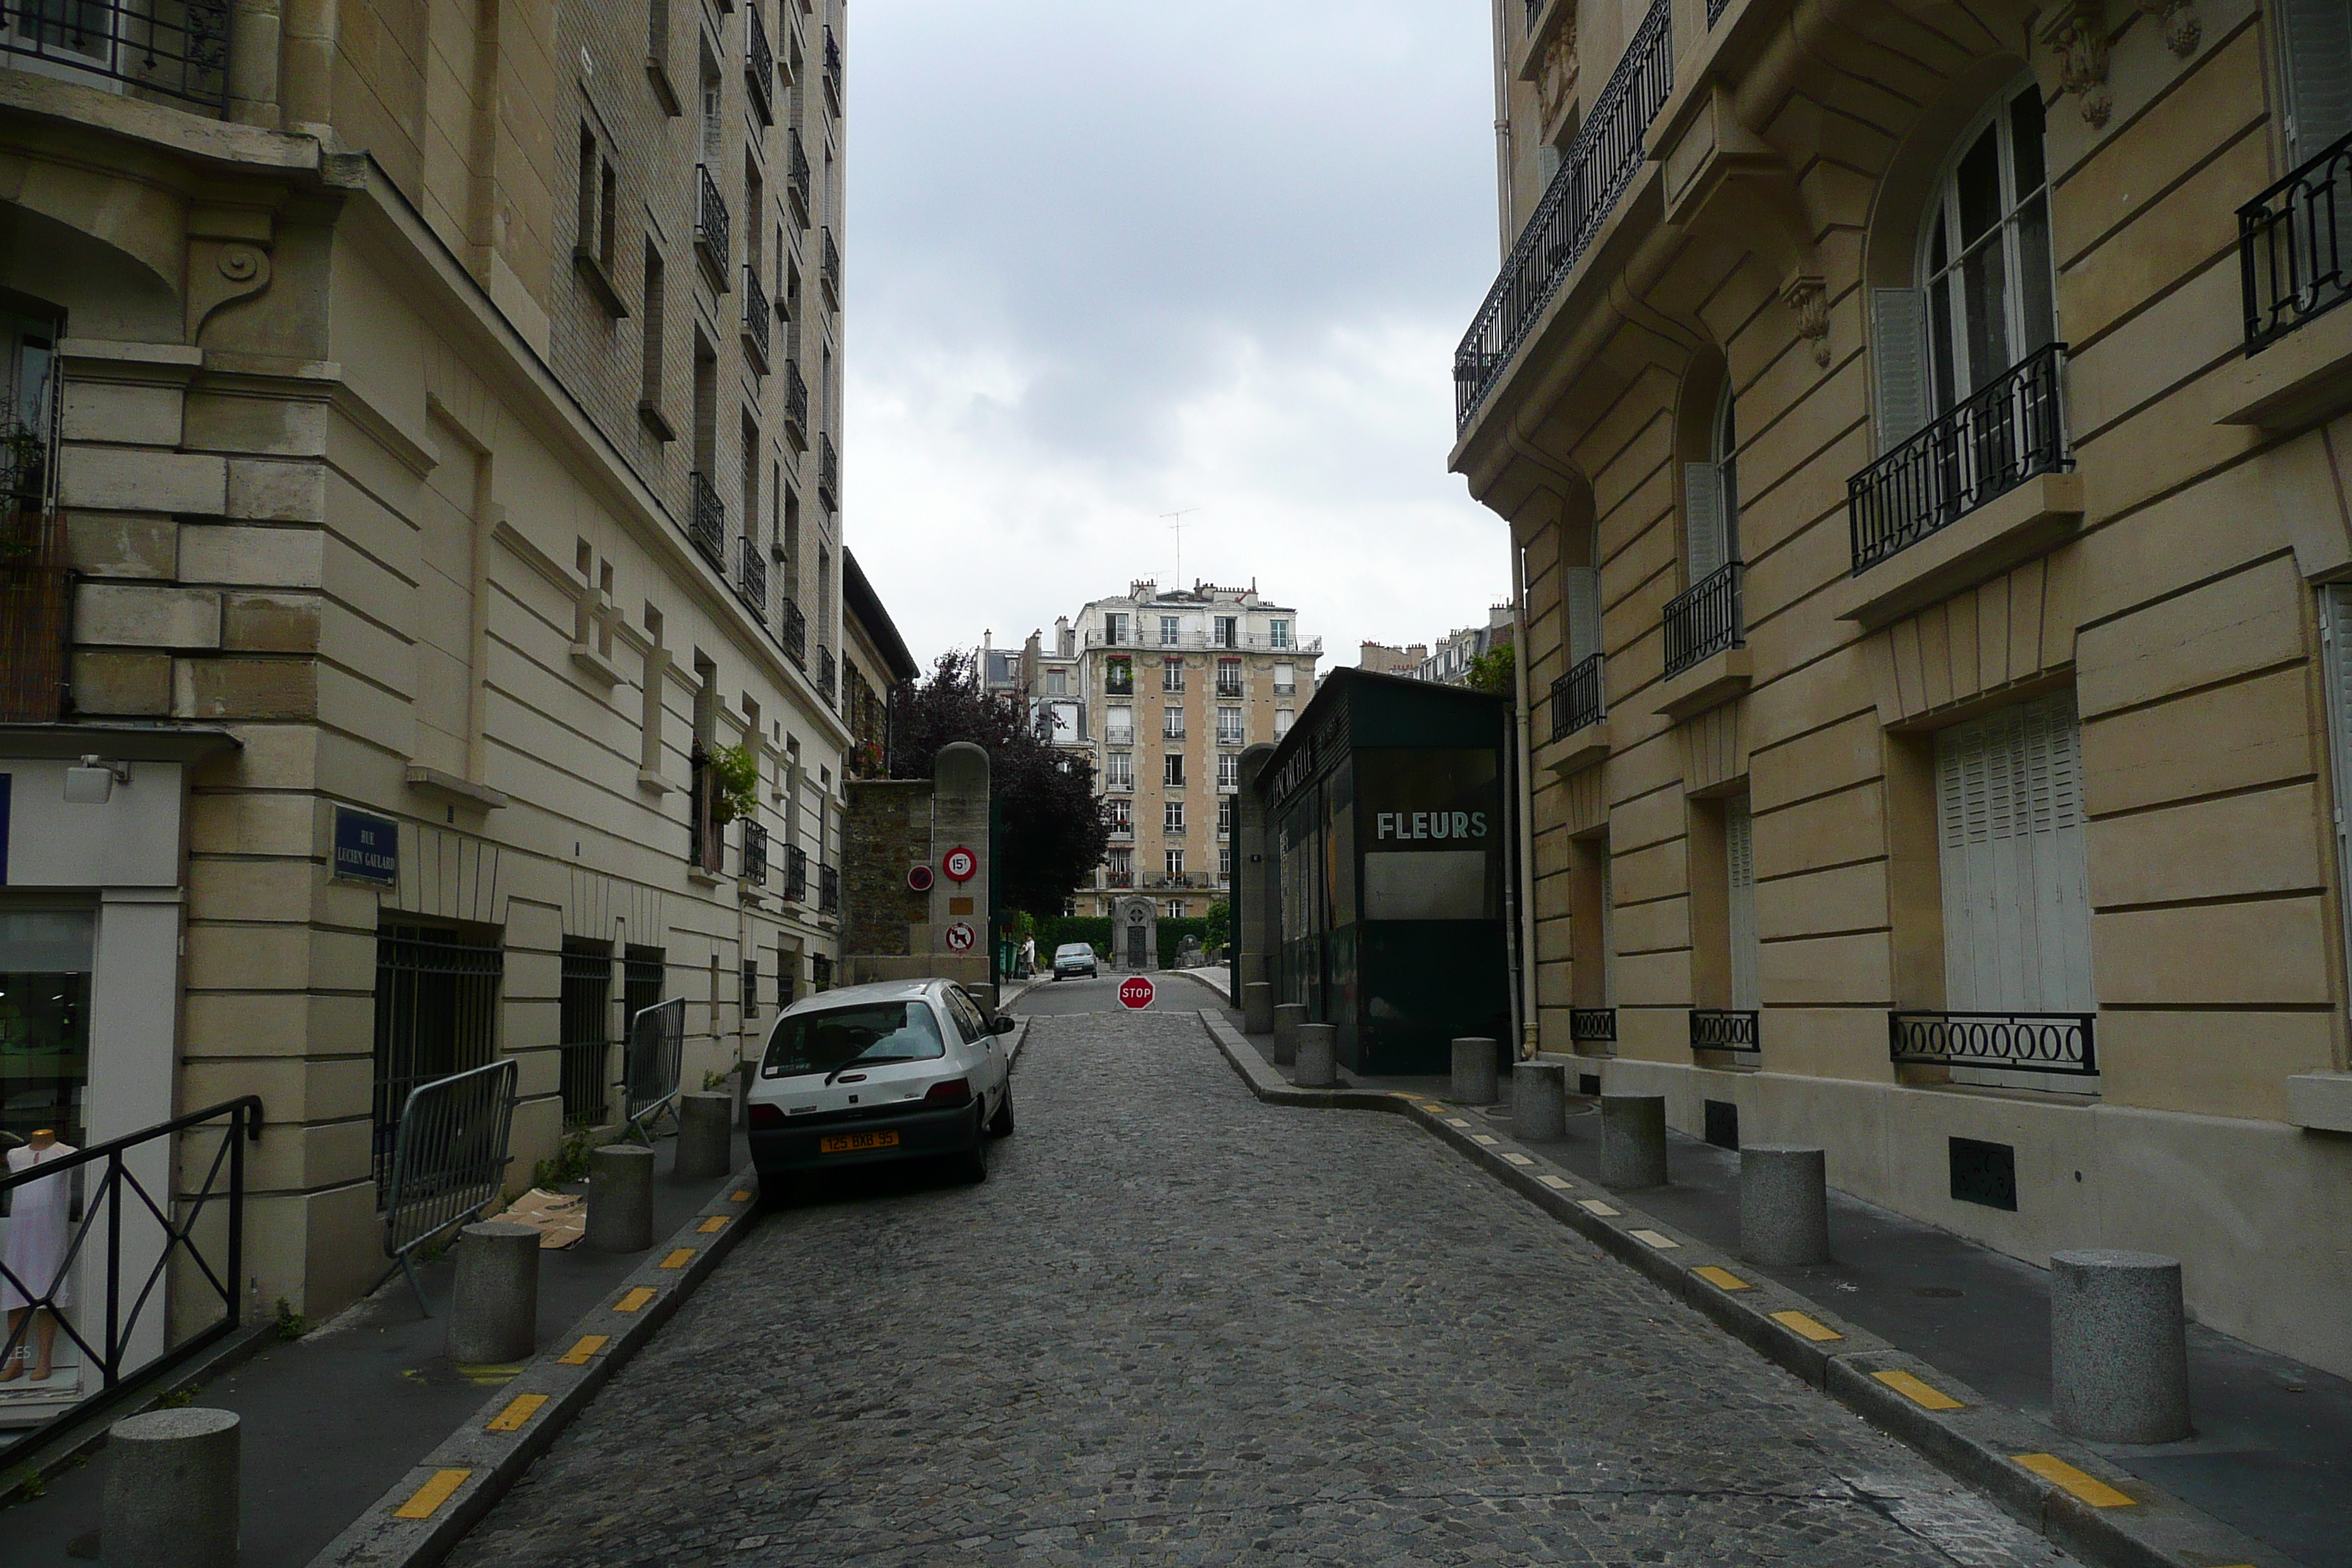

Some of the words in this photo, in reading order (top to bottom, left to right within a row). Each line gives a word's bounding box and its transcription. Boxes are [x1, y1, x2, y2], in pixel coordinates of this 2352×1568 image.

[1377, 812, 1488, 840] FLEURS
[361, 830, 374, 845] RUE
[338, 846, 363, 864] LUCIEN
[1122, 987, 1151, 998] STOP
[827, 1137, 847, 1150] 125
[878, 1131, 893, 1145] 95
